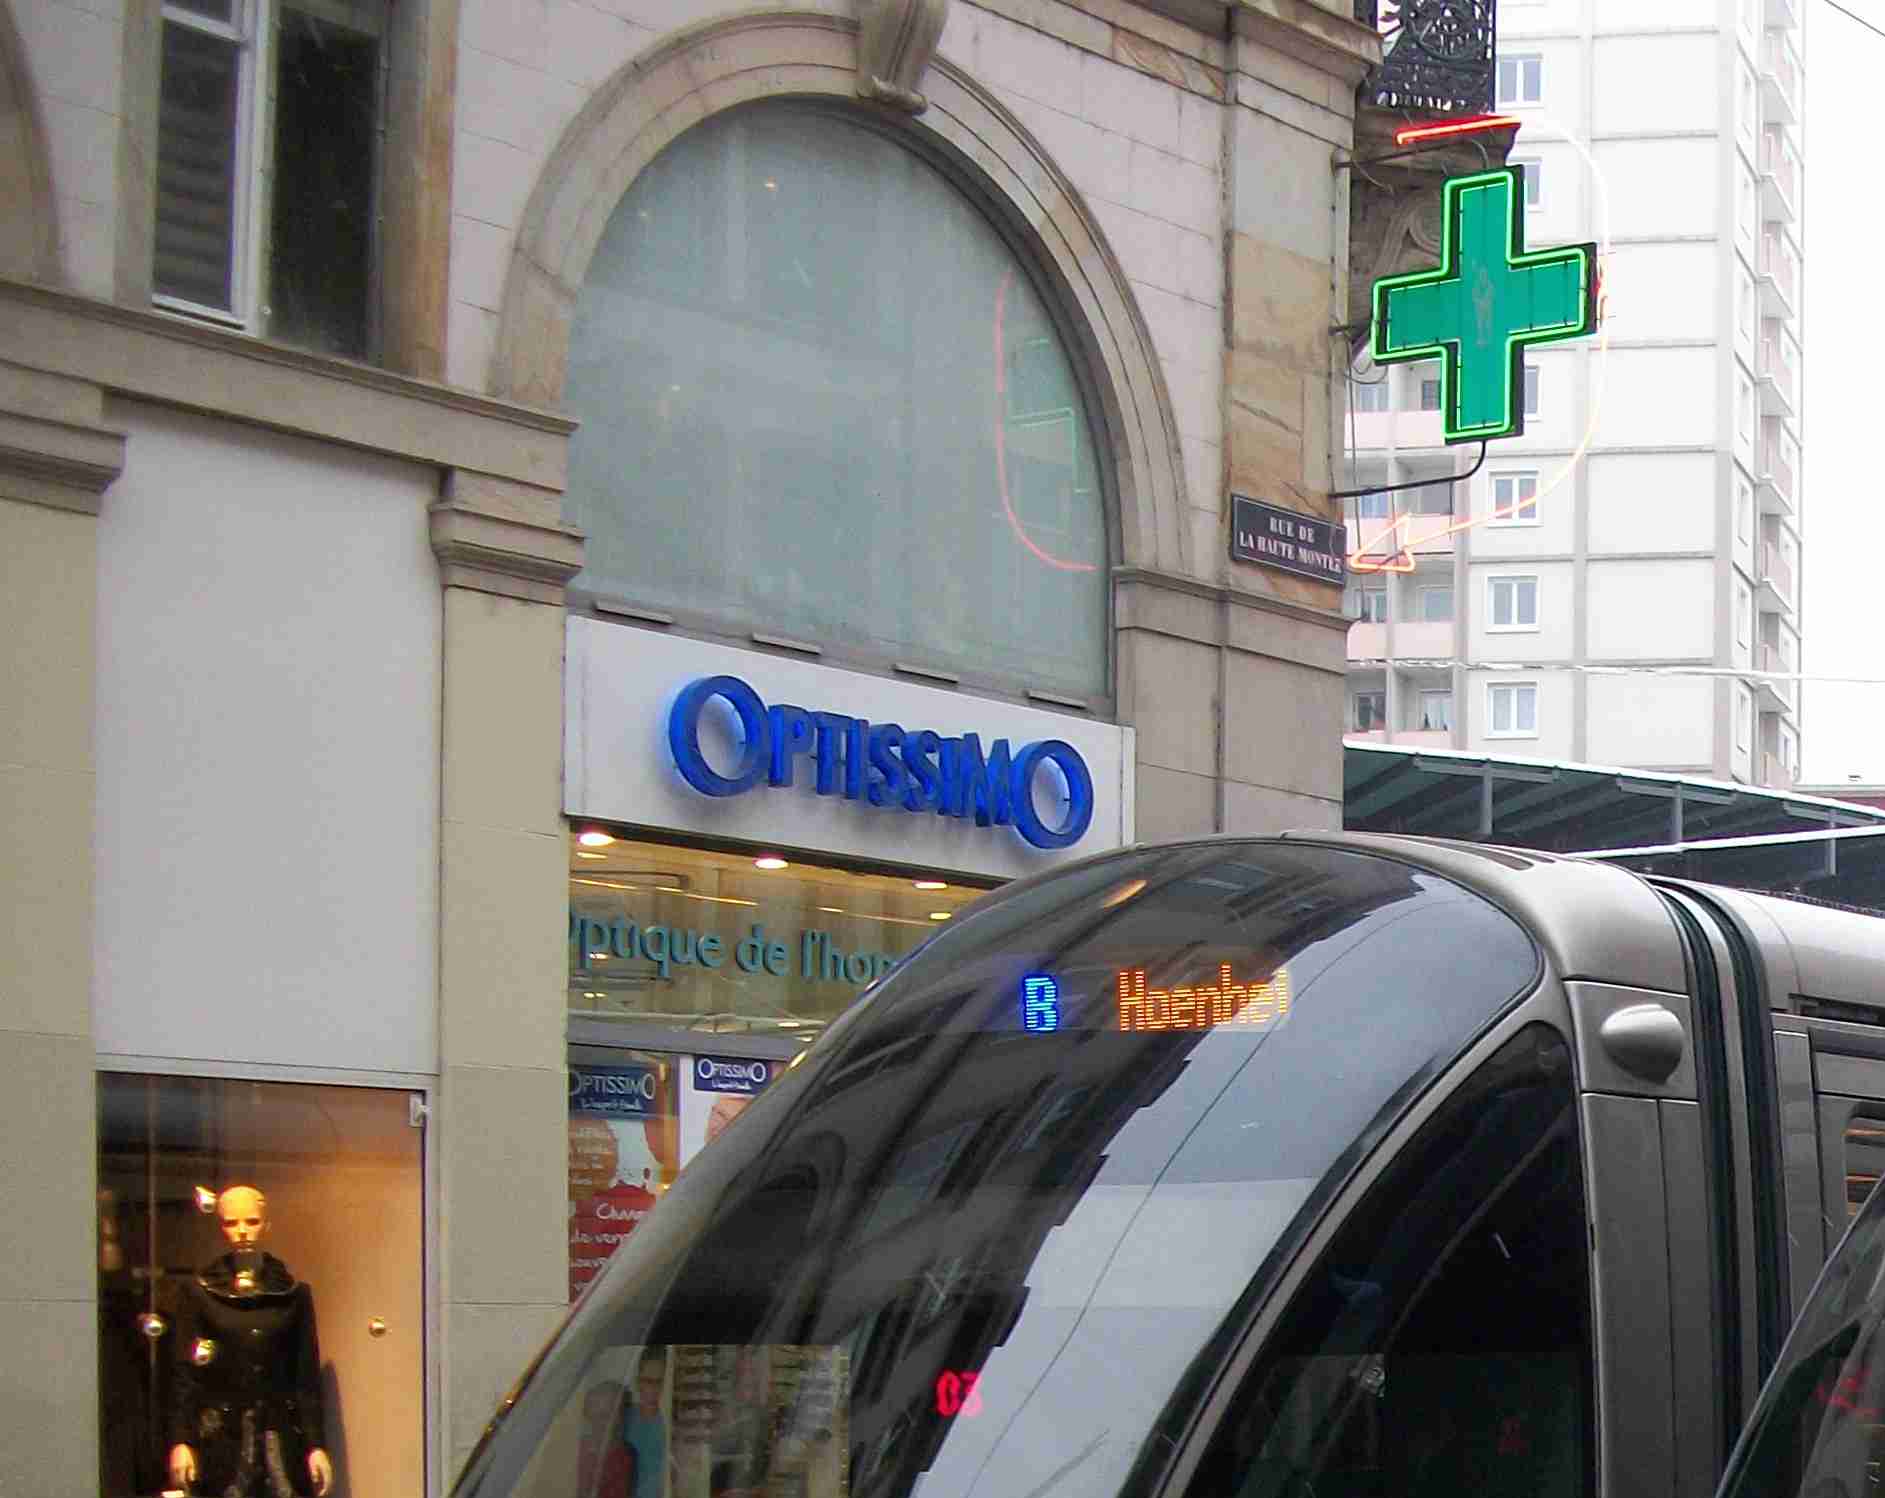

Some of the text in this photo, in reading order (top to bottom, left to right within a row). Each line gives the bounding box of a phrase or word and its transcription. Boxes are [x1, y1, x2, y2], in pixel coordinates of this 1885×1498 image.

[1239, 530, 1255, 550] LA
[1257, 535, 1296, 561] HAUTE
[1269, 516, 1315, 544] RUE DE
[667, 674, 1094, 851] OPTISSIMO
[570, 911, 724, 979] ptique
[735, 922, 792, 978] de
[1024, 975, 1058, 1033] B
